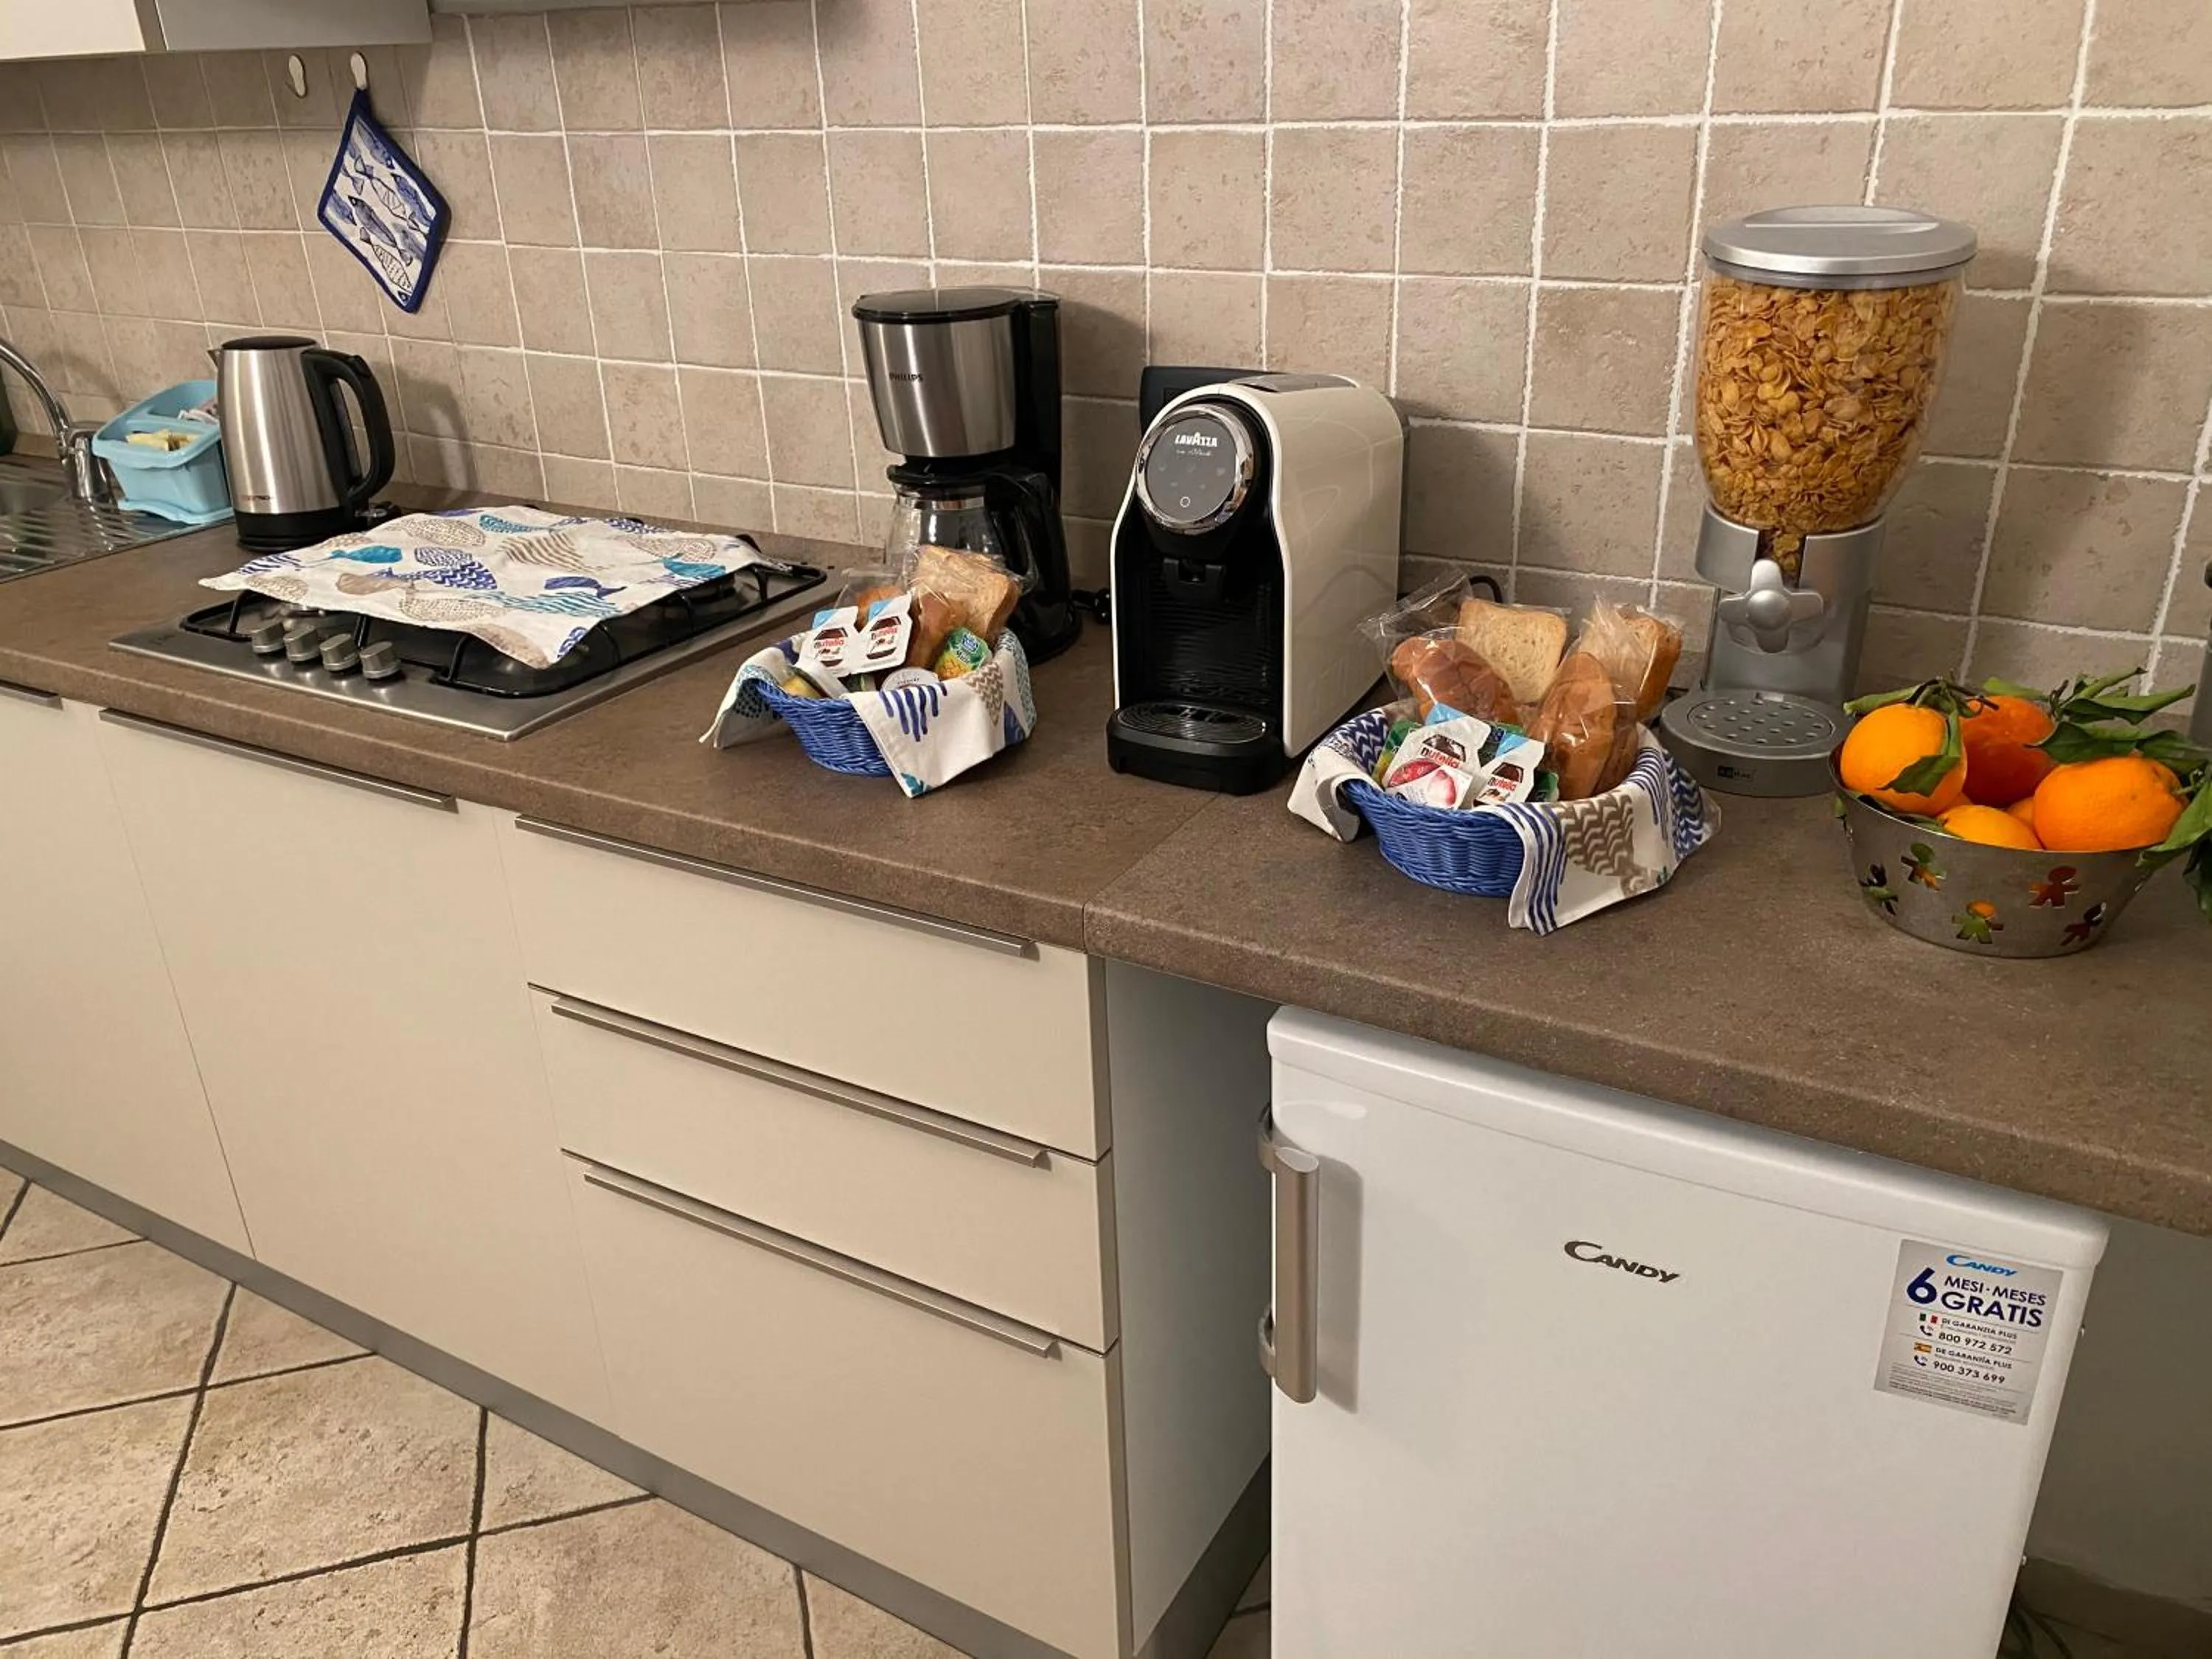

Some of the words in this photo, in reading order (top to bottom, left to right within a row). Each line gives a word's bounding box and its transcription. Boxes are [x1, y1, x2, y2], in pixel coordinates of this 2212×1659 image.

[888, 372, 923, 382] PHILIPS
[1175, 431, 1217, 448] LAVAZZA
[1421, 747, 1460, 769] nutella
[1906, 1267, 1938, 1304] 6
[1944, 1276, 1984, 1293] MESI
[1992, 1286, 2047, 1307] MESES
[1941, 1291, 2043, 1328] GRATIS
[1952, 1321, 1997, 1335] GARANZIA
[1998, 1330, 2017, 1340] PLUS
[1938, 1332, 1961, 1343] 800
[1965, 1338, 1986, 1350] 972
[1989, 1343, 2013, 1355] 572
[1933, 1360, 1955, 1372] 900
[1958, 1367, 1980, 1378] 373
[1983, 1373, 2006, 1384] 699
[1993, 1360, 2012, 1369] PLUS
